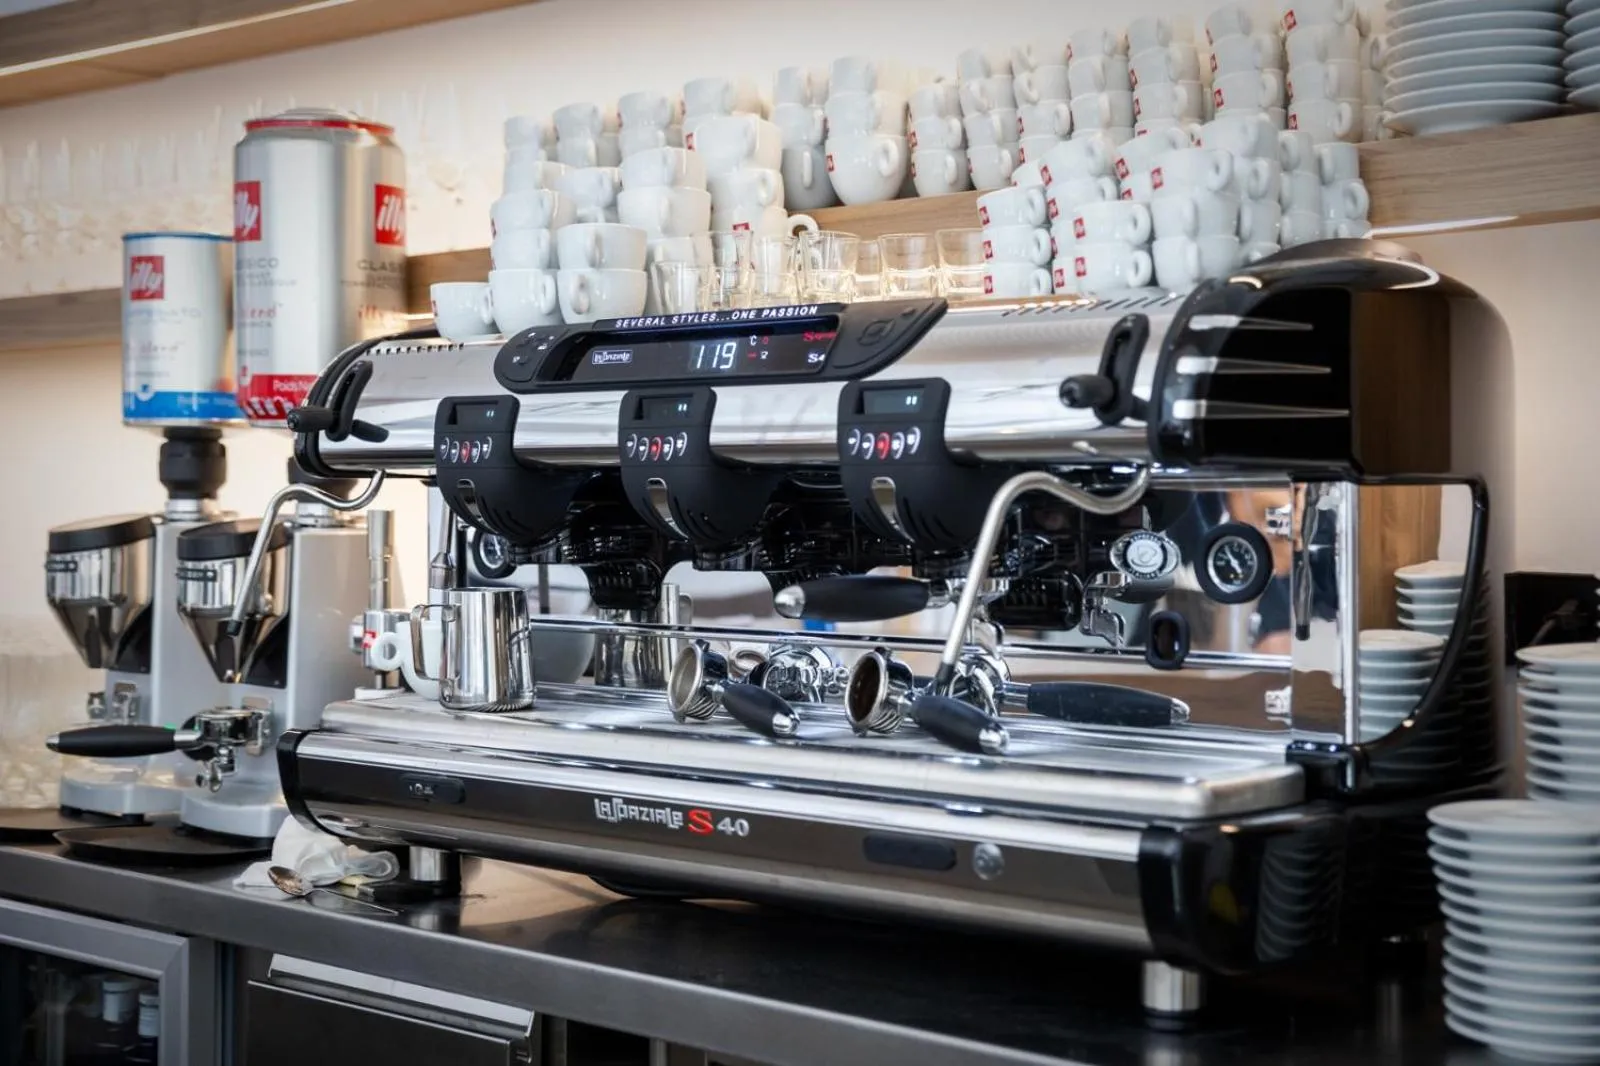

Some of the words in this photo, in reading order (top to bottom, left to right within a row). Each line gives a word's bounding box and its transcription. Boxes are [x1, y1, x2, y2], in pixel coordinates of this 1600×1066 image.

[615, 316, 667, 328] SEVERAL
[761, 305, 819, 318] PASSION
[696, 342, 737, 369] 119
[687, 808, 715, 835] S
[717, 816, 750, 836] 40
